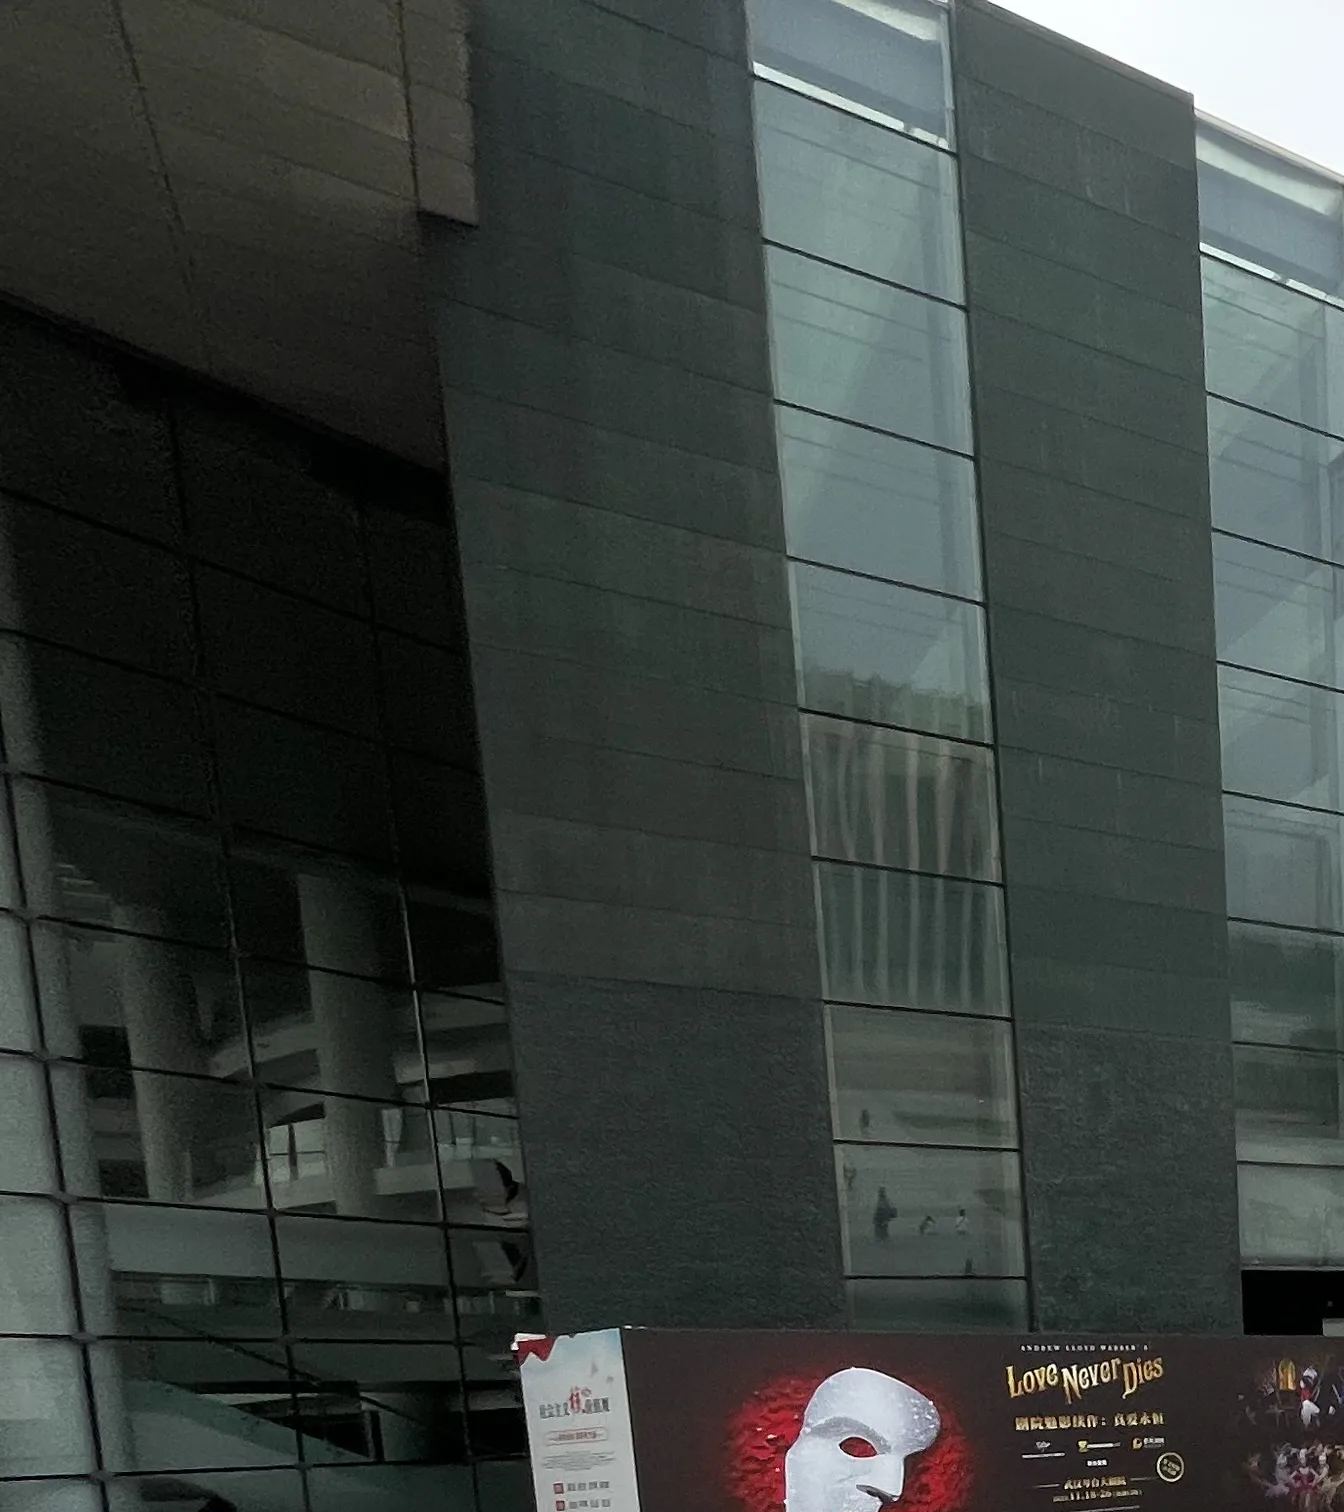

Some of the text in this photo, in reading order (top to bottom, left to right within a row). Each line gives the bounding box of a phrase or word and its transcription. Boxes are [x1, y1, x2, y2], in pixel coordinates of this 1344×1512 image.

[1005, 1356, 1164, 1405] Love Never Dies
